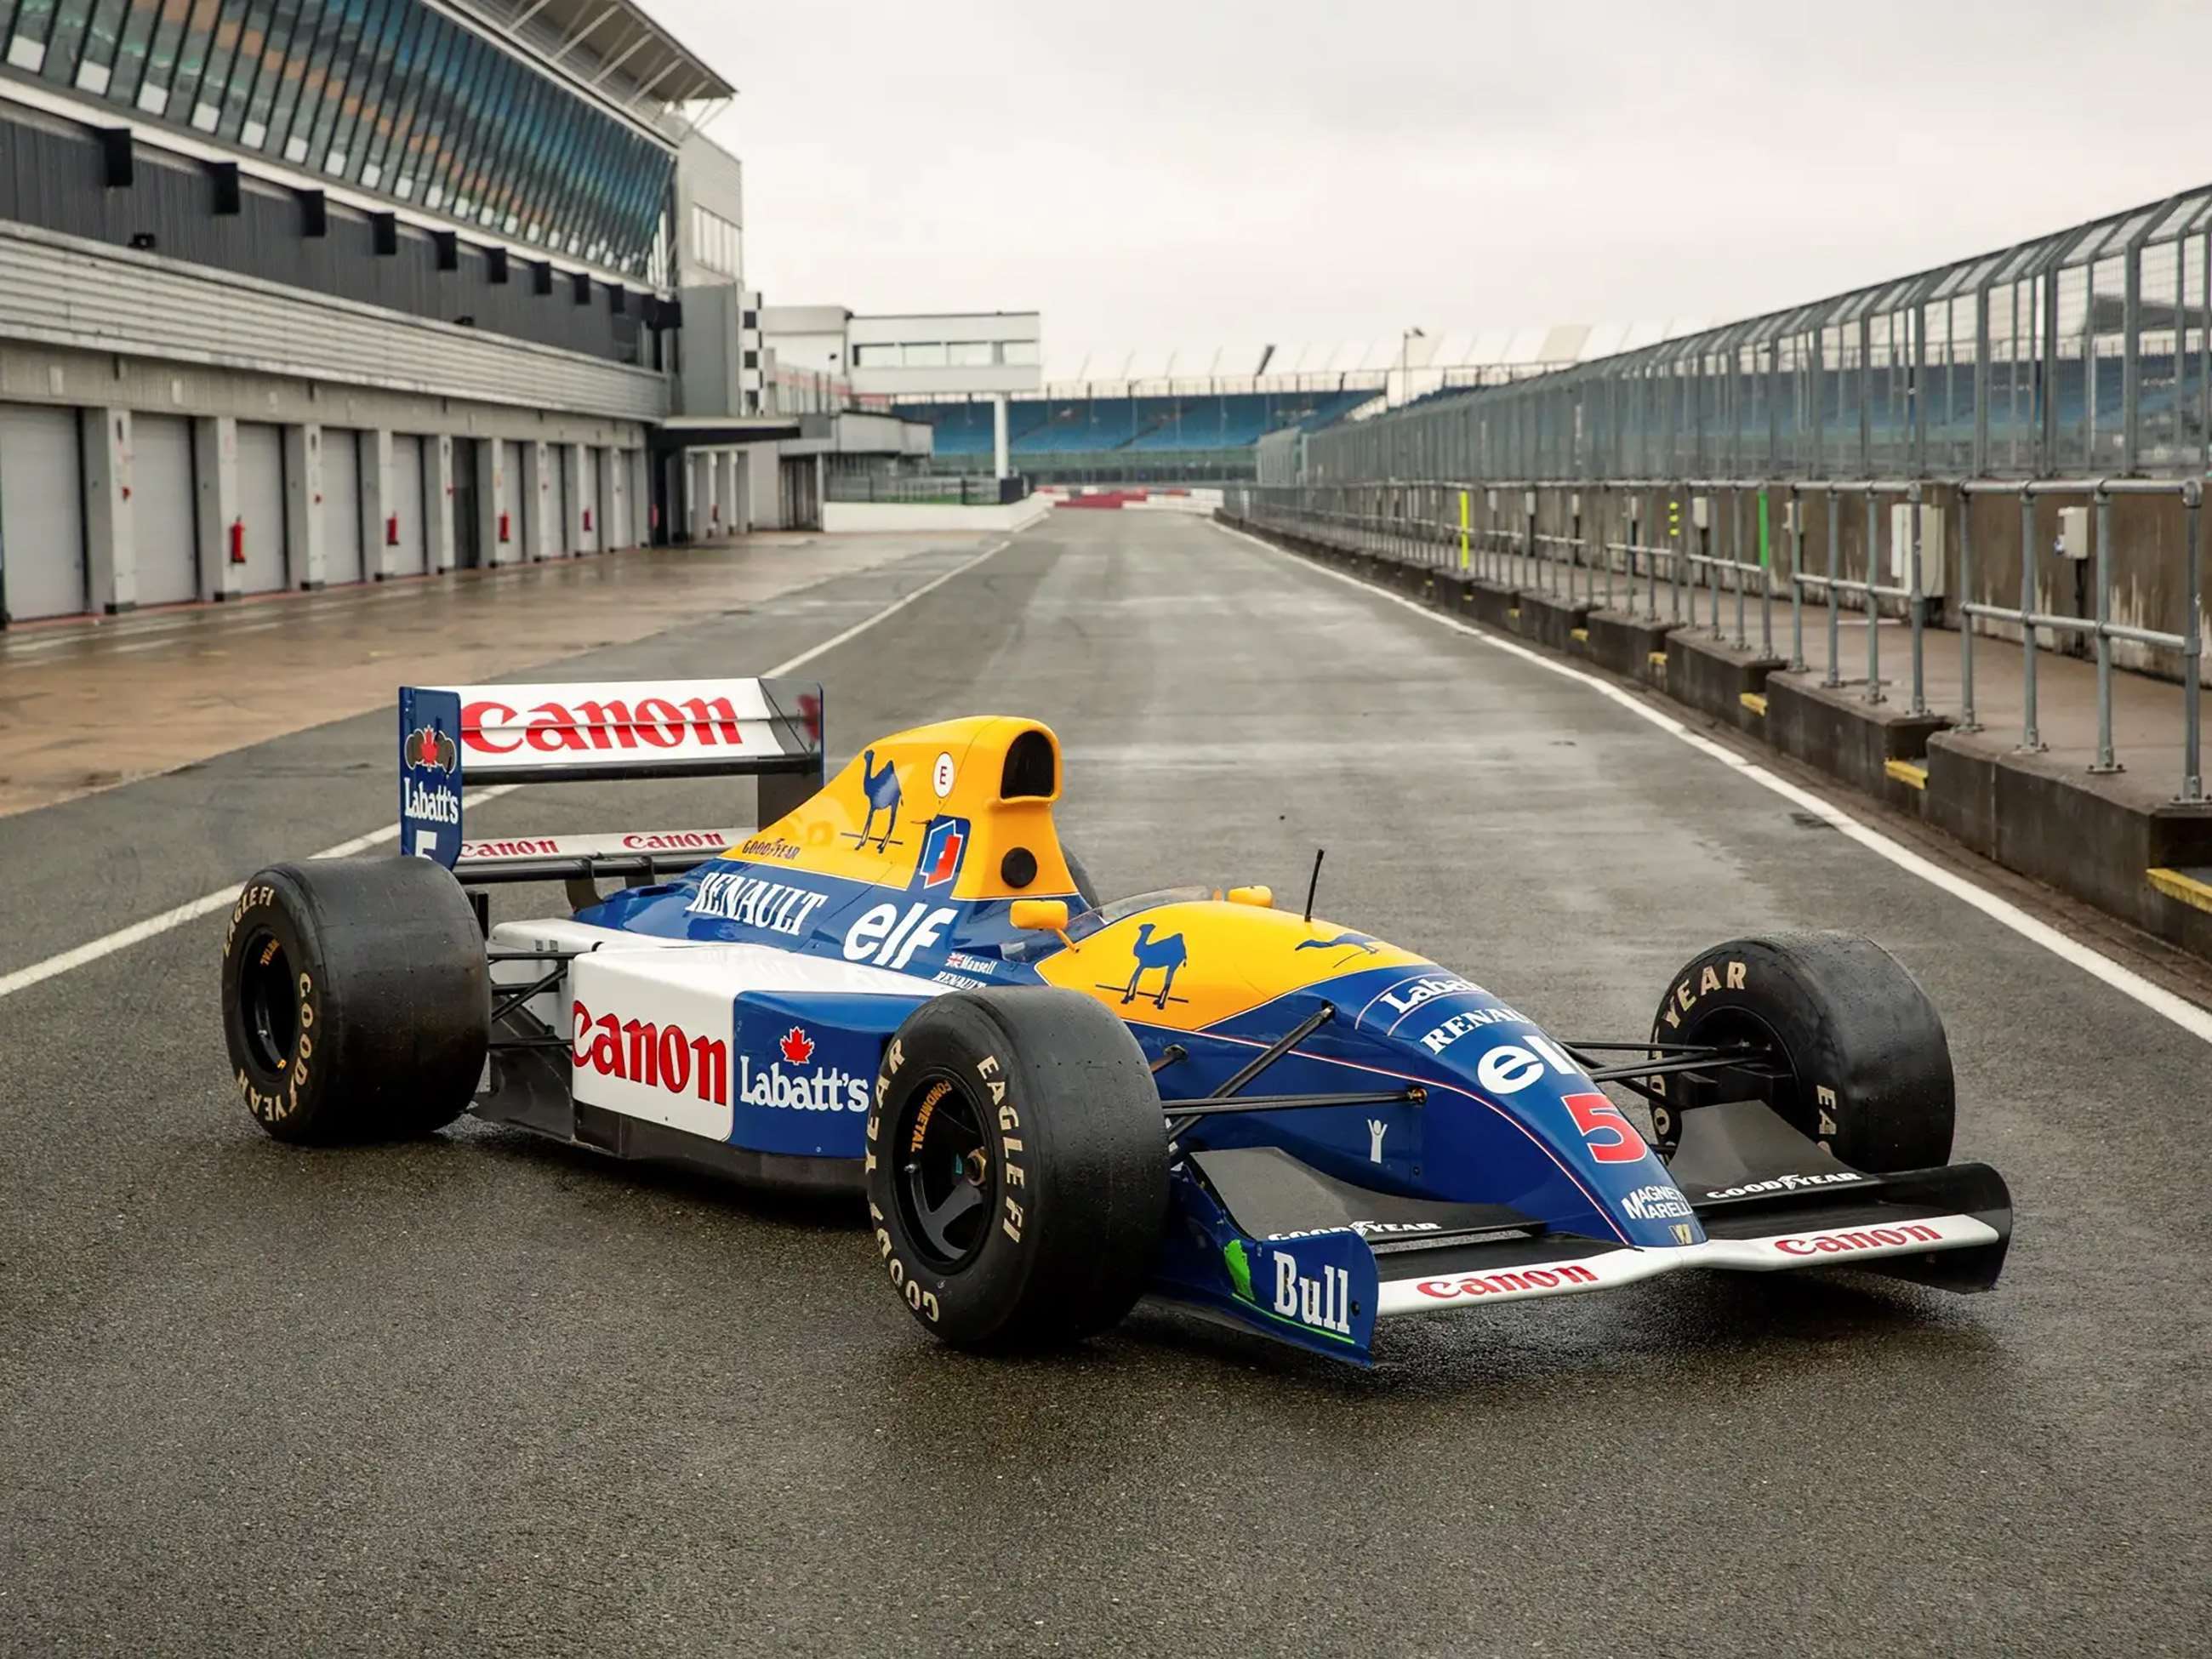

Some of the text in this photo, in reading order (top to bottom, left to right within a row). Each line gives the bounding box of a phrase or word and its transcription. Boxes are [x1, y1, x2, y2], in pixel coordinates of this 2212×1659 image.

[460, 697, 743, 754] Canon
[404, 778, 459, 824] Labatt's
[938, 766, 948, 785] E
[623, 832, 726, 850] Canon
[685, 872, 829, 936] RENAULT
[843, 902, 958, 970] elf
[961, 955, 998, 975] Mansell
[573, 1000, 727, 1106] Canon
[1478, 1035, 1591, 1094] el
[739, 1055, 869, 1112] Labatt's
[910, 1080, 953, 1152] FONDMETAL
[976, 1055, 1025, 1189] EAGLE
[1560, 1092, 1648, 1164] 5
[1707, 1172, 1862, 1200] GOODYEAR
[1775, 1224, 1943, 1255] Canon
[1274, 1251, 1350, 1334] Bull
[1417, 1265, 1600, 1300] Canon
